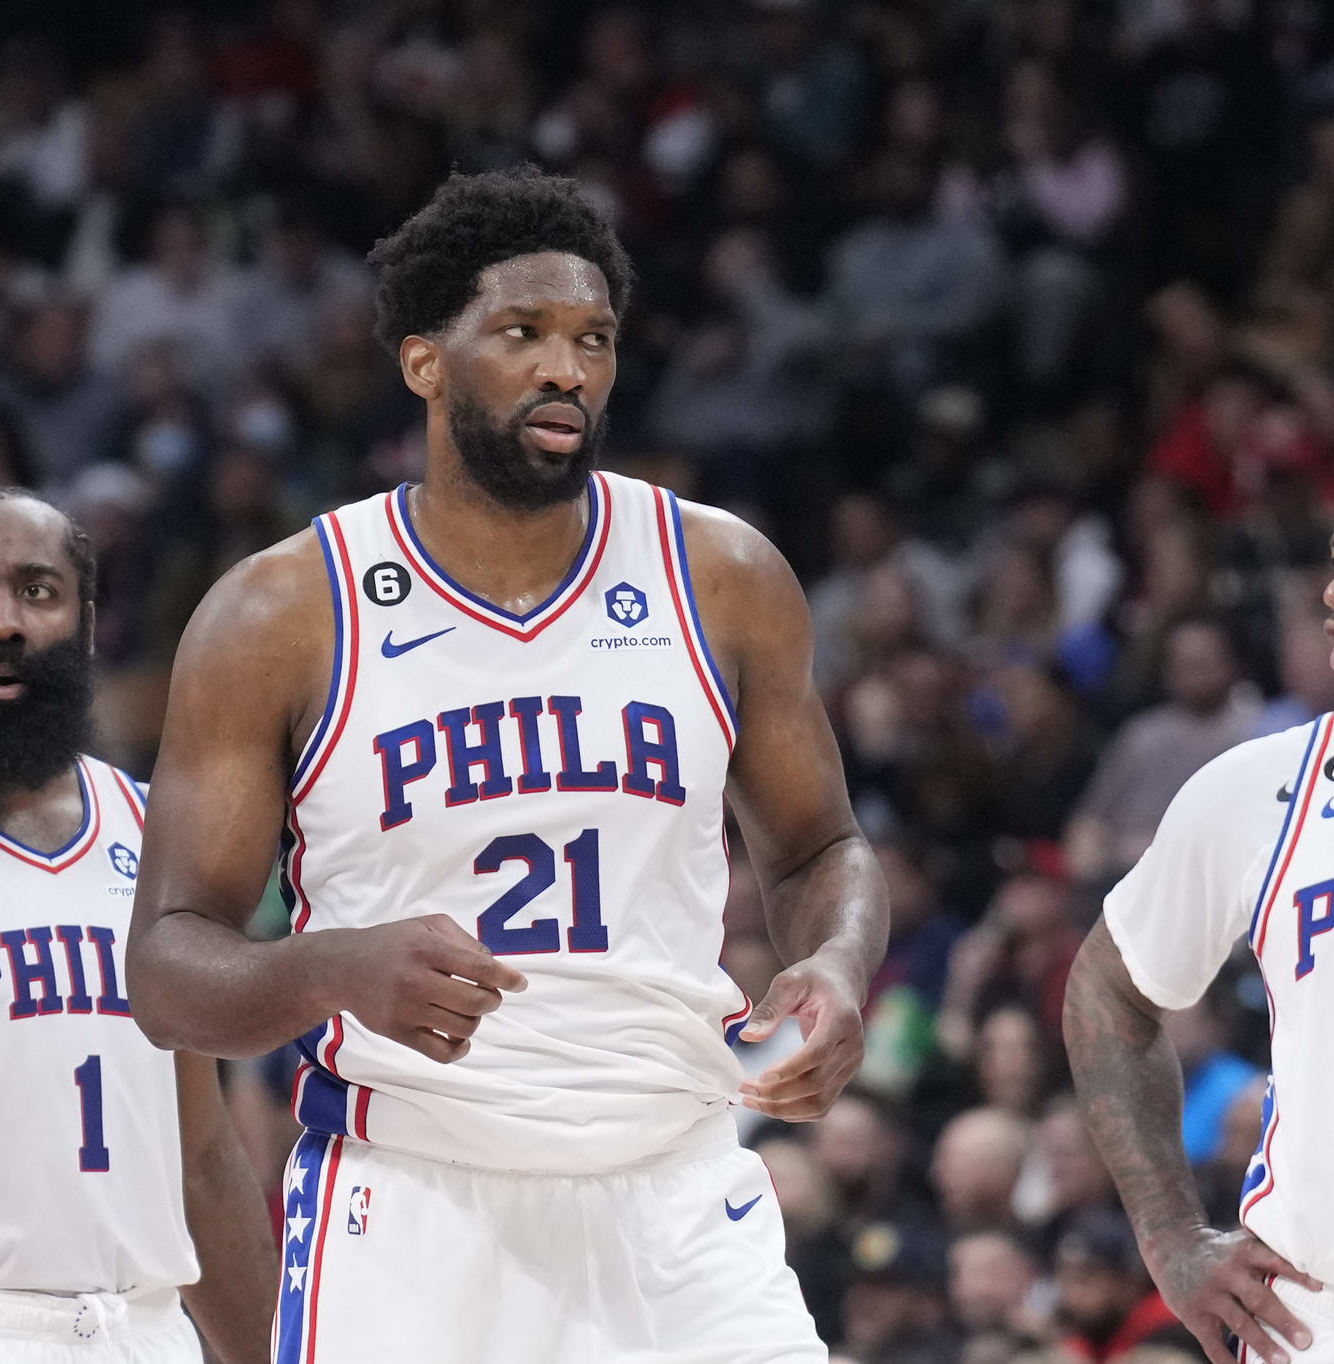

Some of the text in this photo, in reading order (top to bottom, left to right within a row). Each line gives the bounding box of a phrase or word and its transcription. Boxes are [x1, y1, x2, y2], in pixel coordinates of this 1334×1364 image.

[373, 568, 402, 600] 6
[590, 634, 672, 649] crypto.com
[373, 695, 686, 832] PHILA
[473, 828, 608, 956] 21
[74, 1055, 110, 1173] 1
